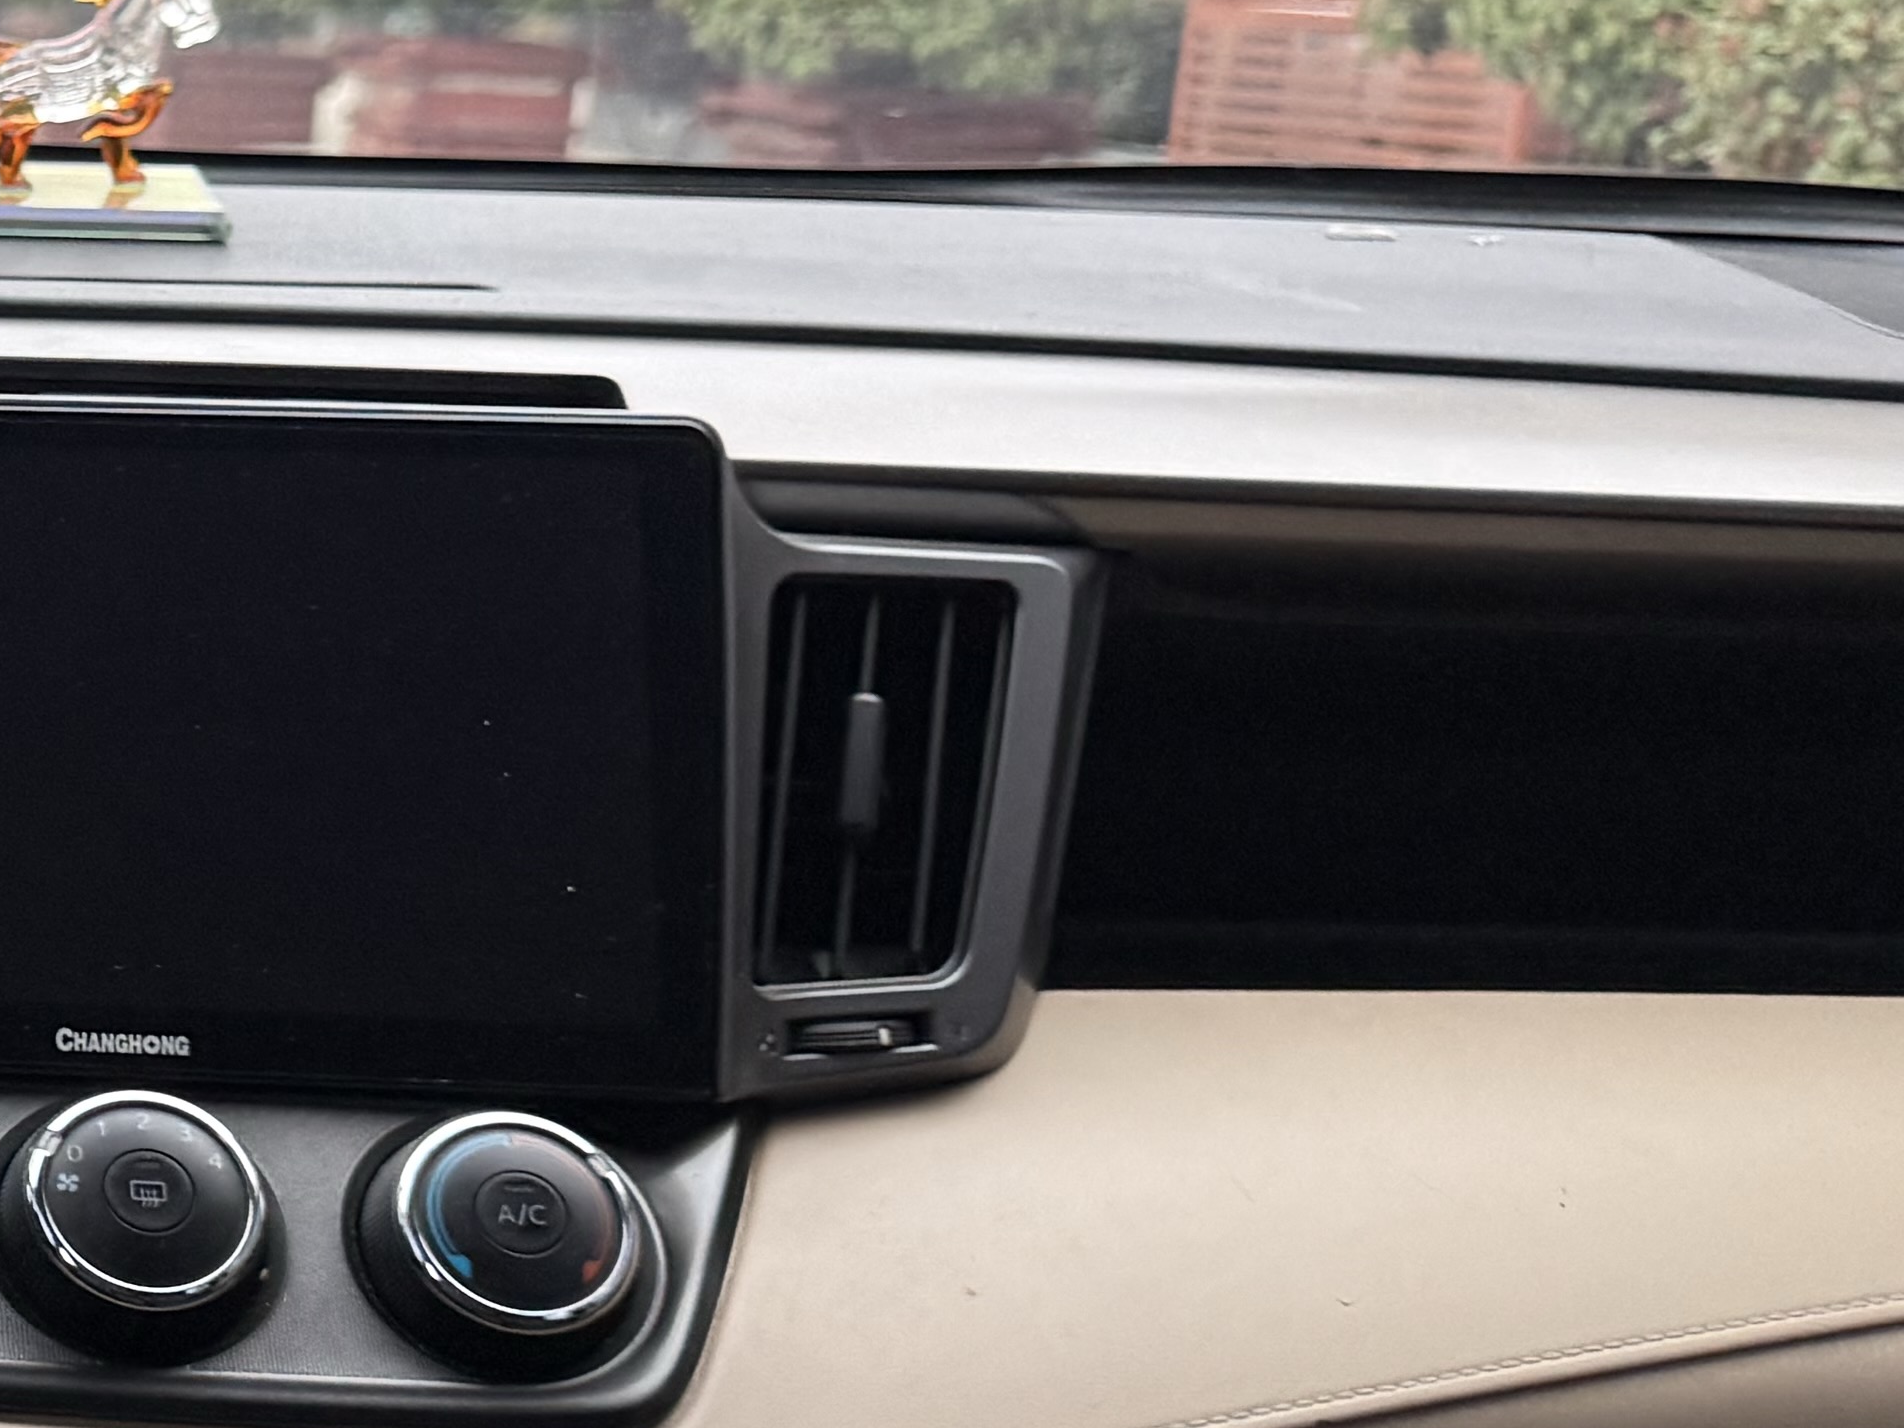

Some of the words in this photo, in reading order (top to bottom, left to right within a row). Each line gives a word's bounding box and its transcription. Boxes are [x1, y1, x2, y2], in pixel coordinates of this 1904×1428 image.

[55, 1026, 192, 1057] CHANGHONG
[97, 1121, 107, 1137] 1
[136, 1114, 153, 1130] 2
[179, 1126, 193, 1143] 3
[66, 1144, 84, 1162] 0
[208, 1152, 225, 1170] 4
[497, 1203, 547, 1227] A/C
